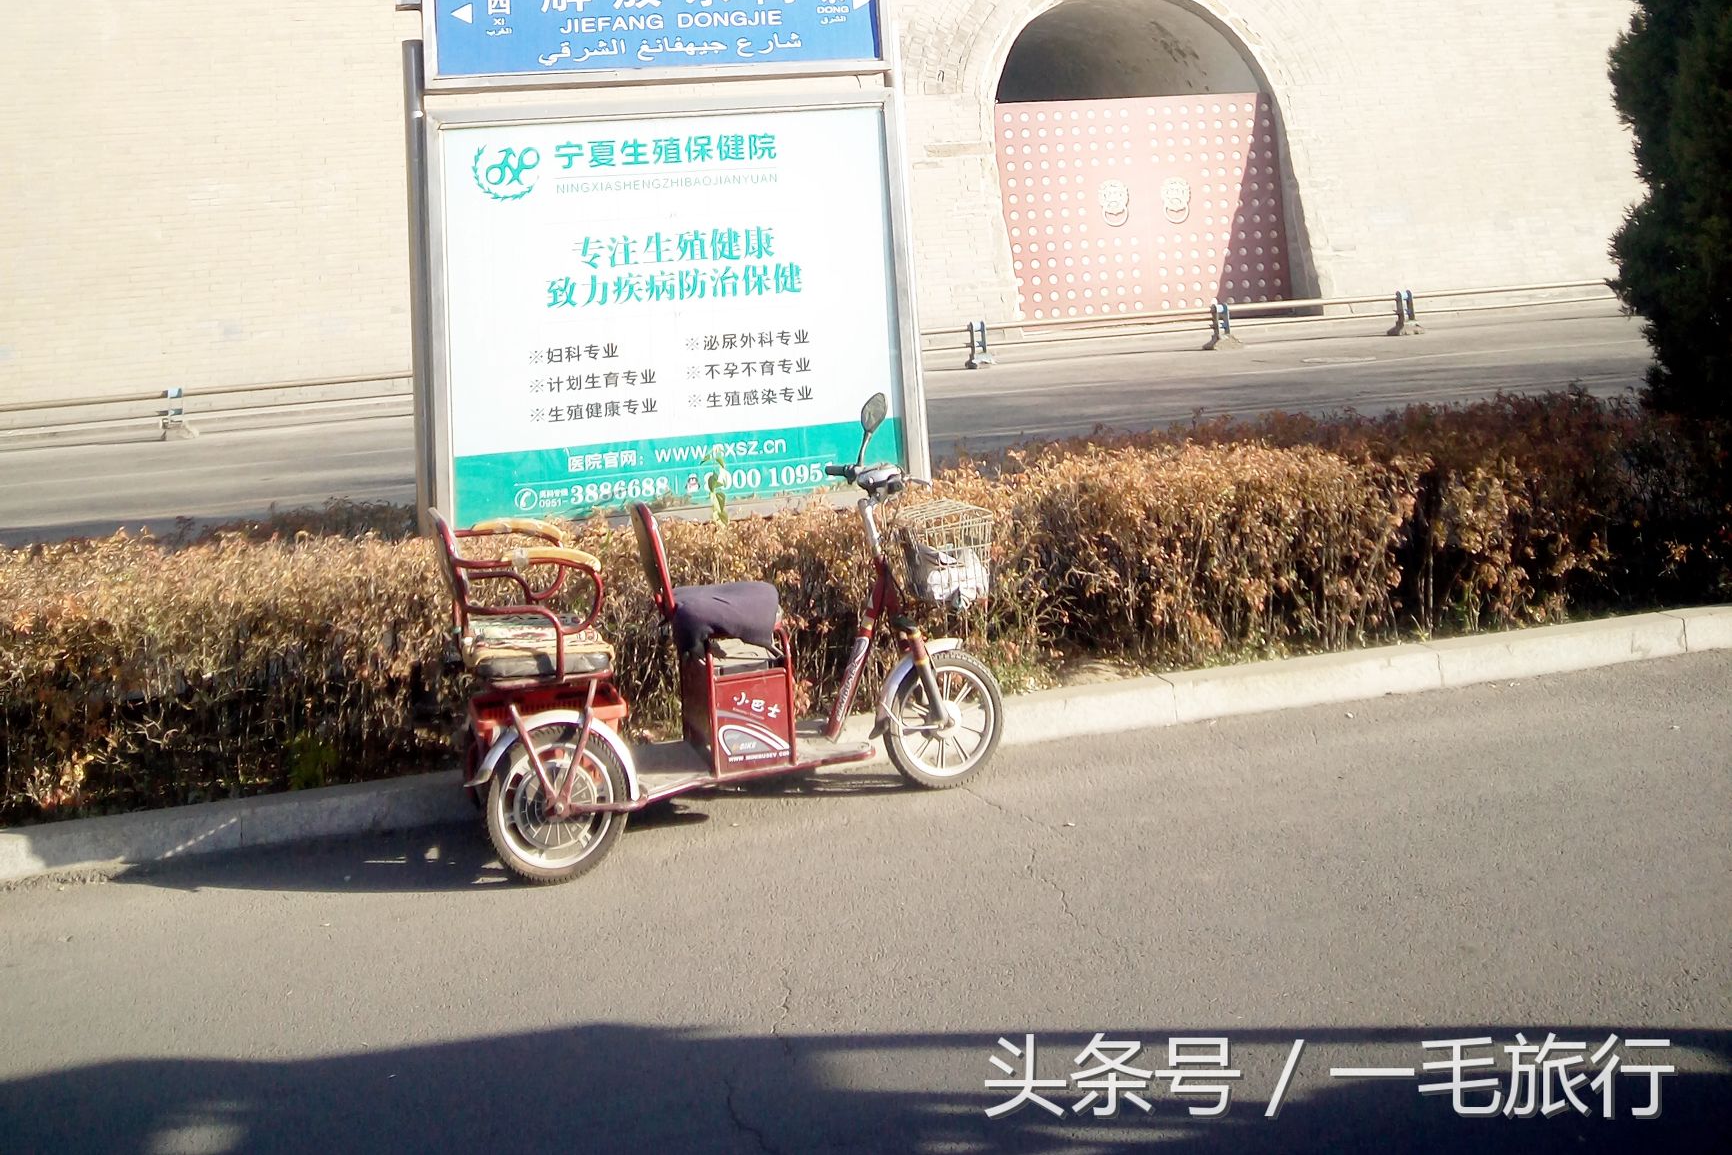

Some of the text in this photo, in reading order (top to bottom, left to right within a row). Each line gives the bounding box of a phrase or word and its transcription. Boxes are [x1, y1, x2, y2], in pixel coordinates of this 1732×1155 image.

[493, 17, 506, 26] XI
[816, 5, 850, 14] DONG
[560, 10, 783, 34] JIEFANG DONGJIE
[553, 133, 778, 170] 宁夏生殖保健院
[555, 172, 778, 195] NINGXIASHENGZHIBAOJIANYUAN
[572, 226, 775, 270] 专注生殖健康
[546, 262, 804, 309] 致力疾病防治保健
[703, 329, 810, 351] 泌尿外科专业
[546, 342, 620, 365] 妇科专业
[546, 368, 657, 393] 计划生育专业
[704, 357, 812, 380] 不孕不育专业
[706, 385, 814, 409] 生殖感染专业
[548, 397, 659, 423] 生殖健康专业
